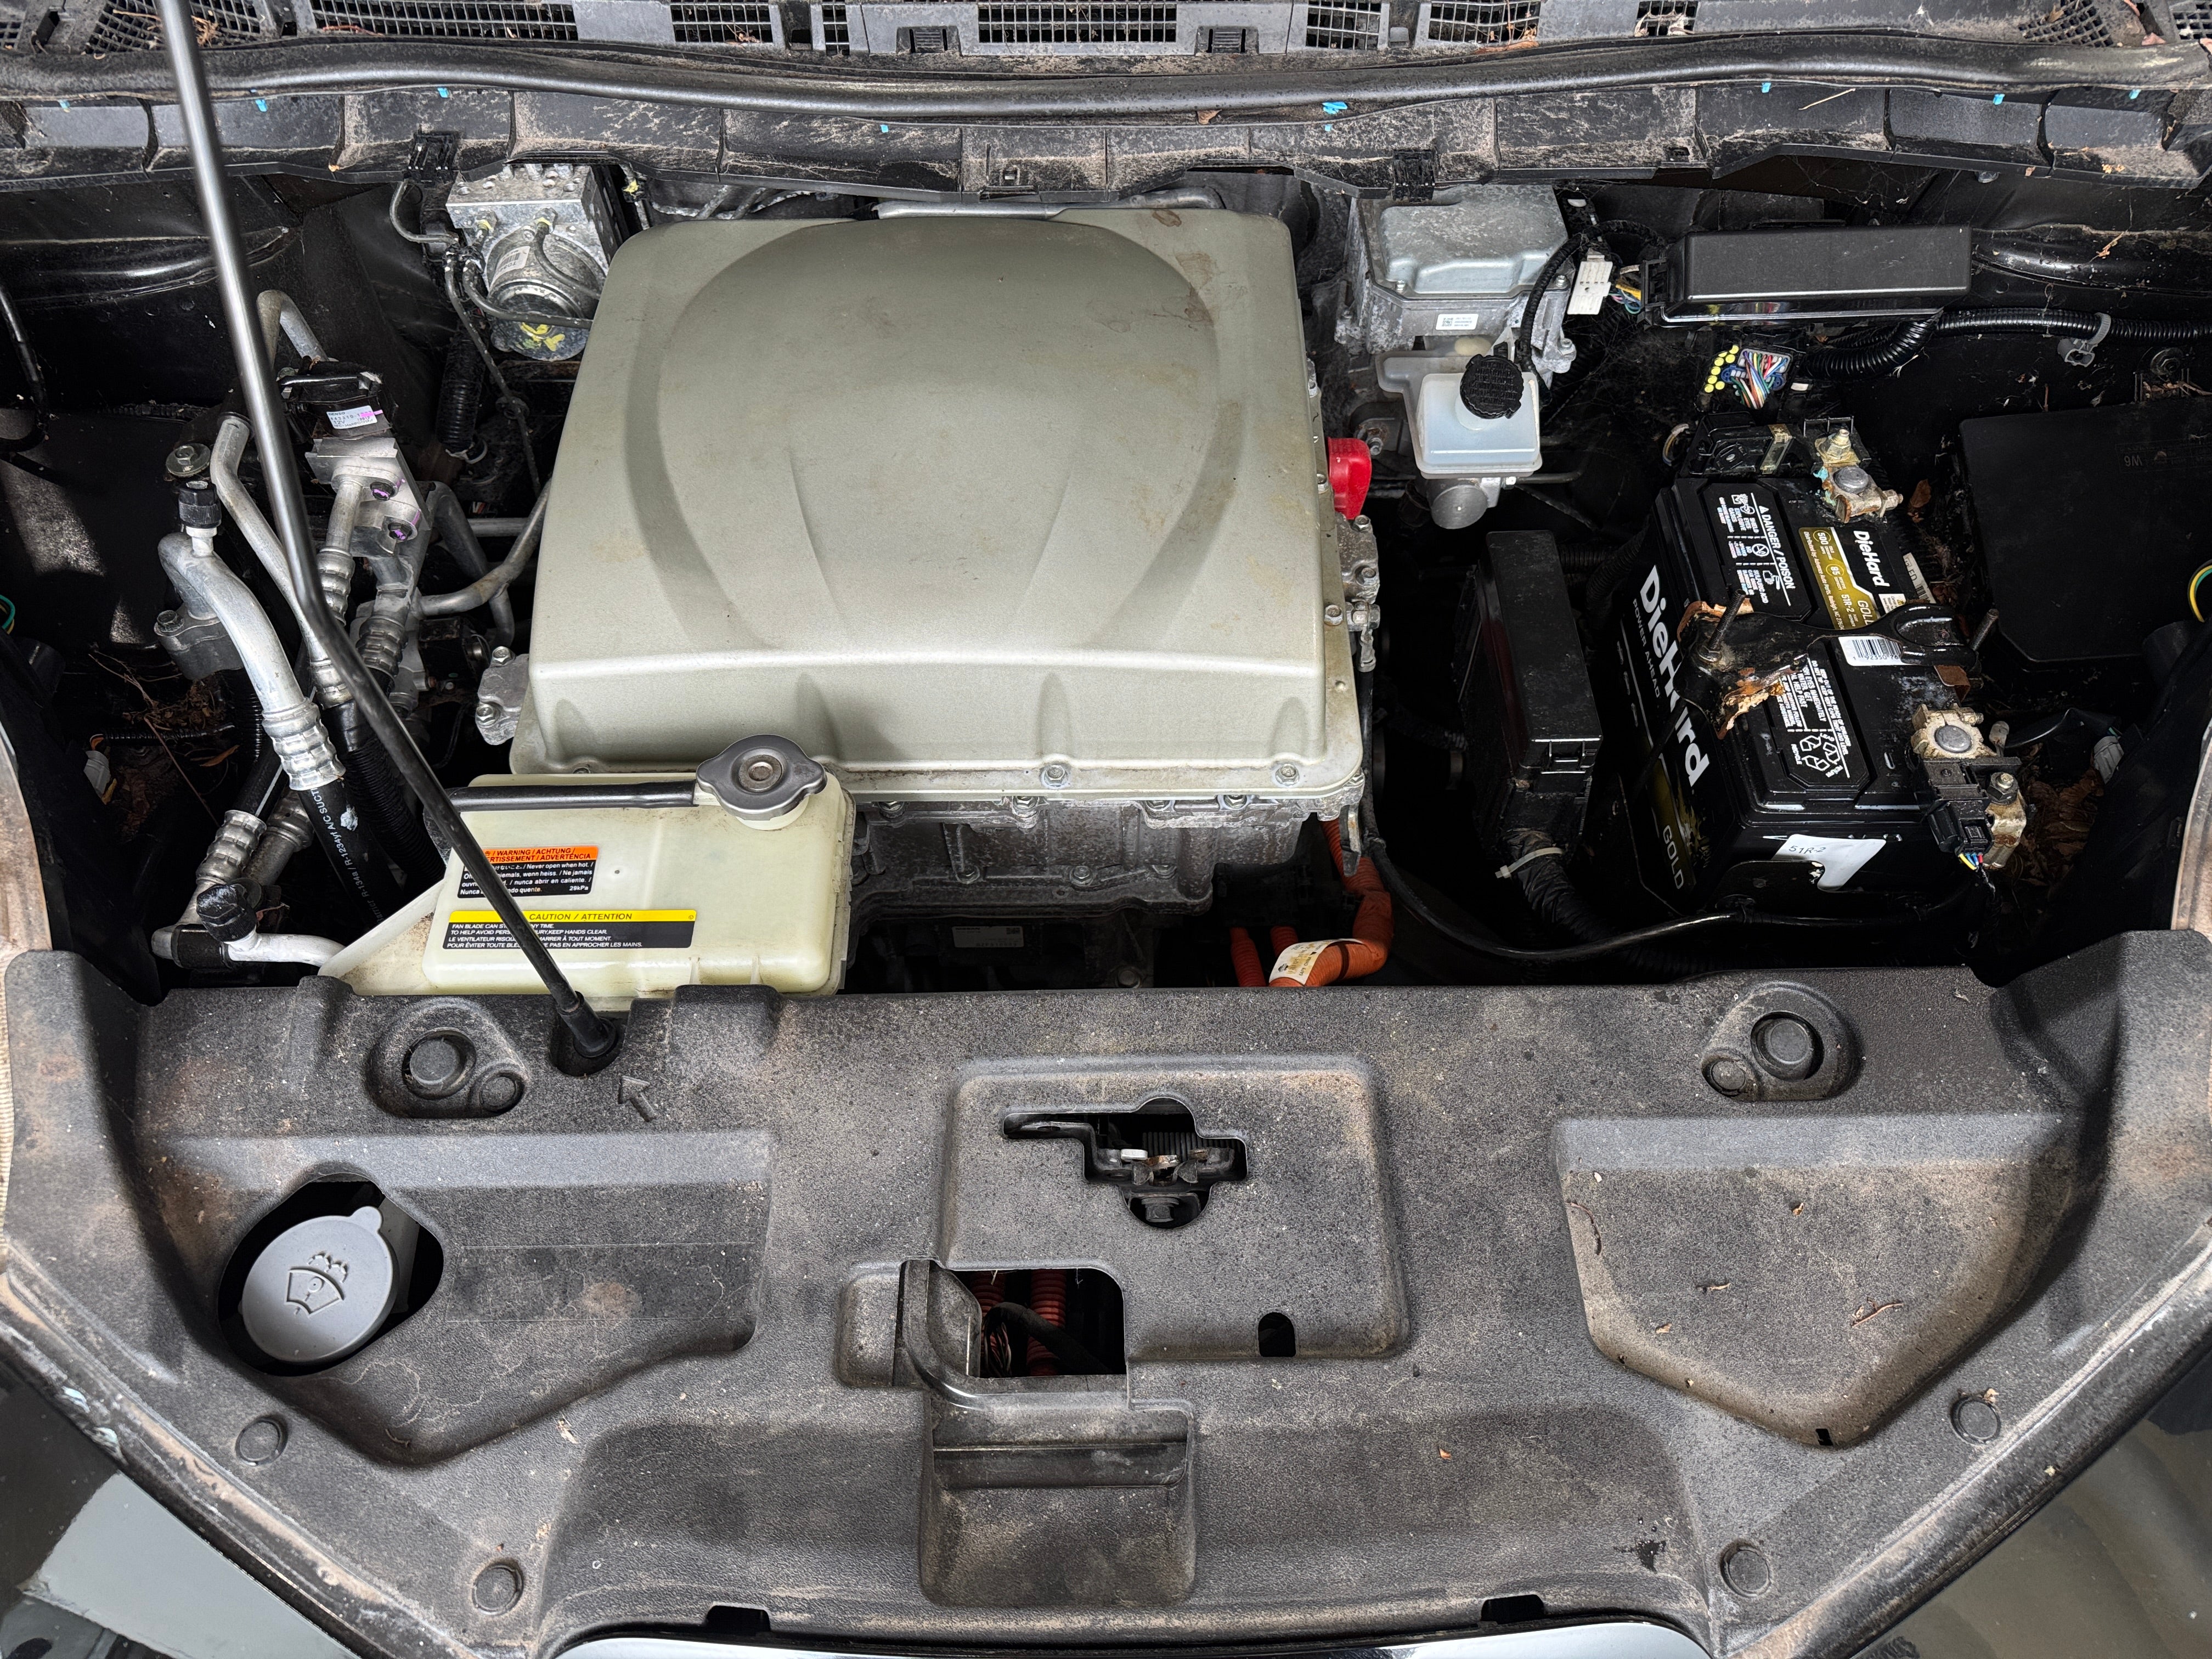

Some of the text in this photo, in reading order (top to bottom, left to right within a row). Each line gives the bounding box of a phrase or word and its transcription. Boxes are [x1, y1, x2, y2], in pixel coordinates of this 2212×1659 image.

[1817, 532, 1829, 544] 500
[1762, 514, 1781, 549] DANGER
[1776, 557, 1796, 589] POISON
[1854, 531, 1890, 587] DieHard
[1841, 594, 1855, 612] 51R-2
[1633, 599, 1660, 698] POWER AHEAD
[1792, 681, 1803, 693] HELP
[1805, 676, 1816, 688] EYES
[1797, 695, 1808, 708] FAST
[1803, 692, 1813, 702] GET
[311, 787, 328, 814] SUCTI
[1663, 824, 1684, 889] GOLD
[1788, 845, 1826, 854] 51R-2
[352, 871, 370, 898] R-134a
